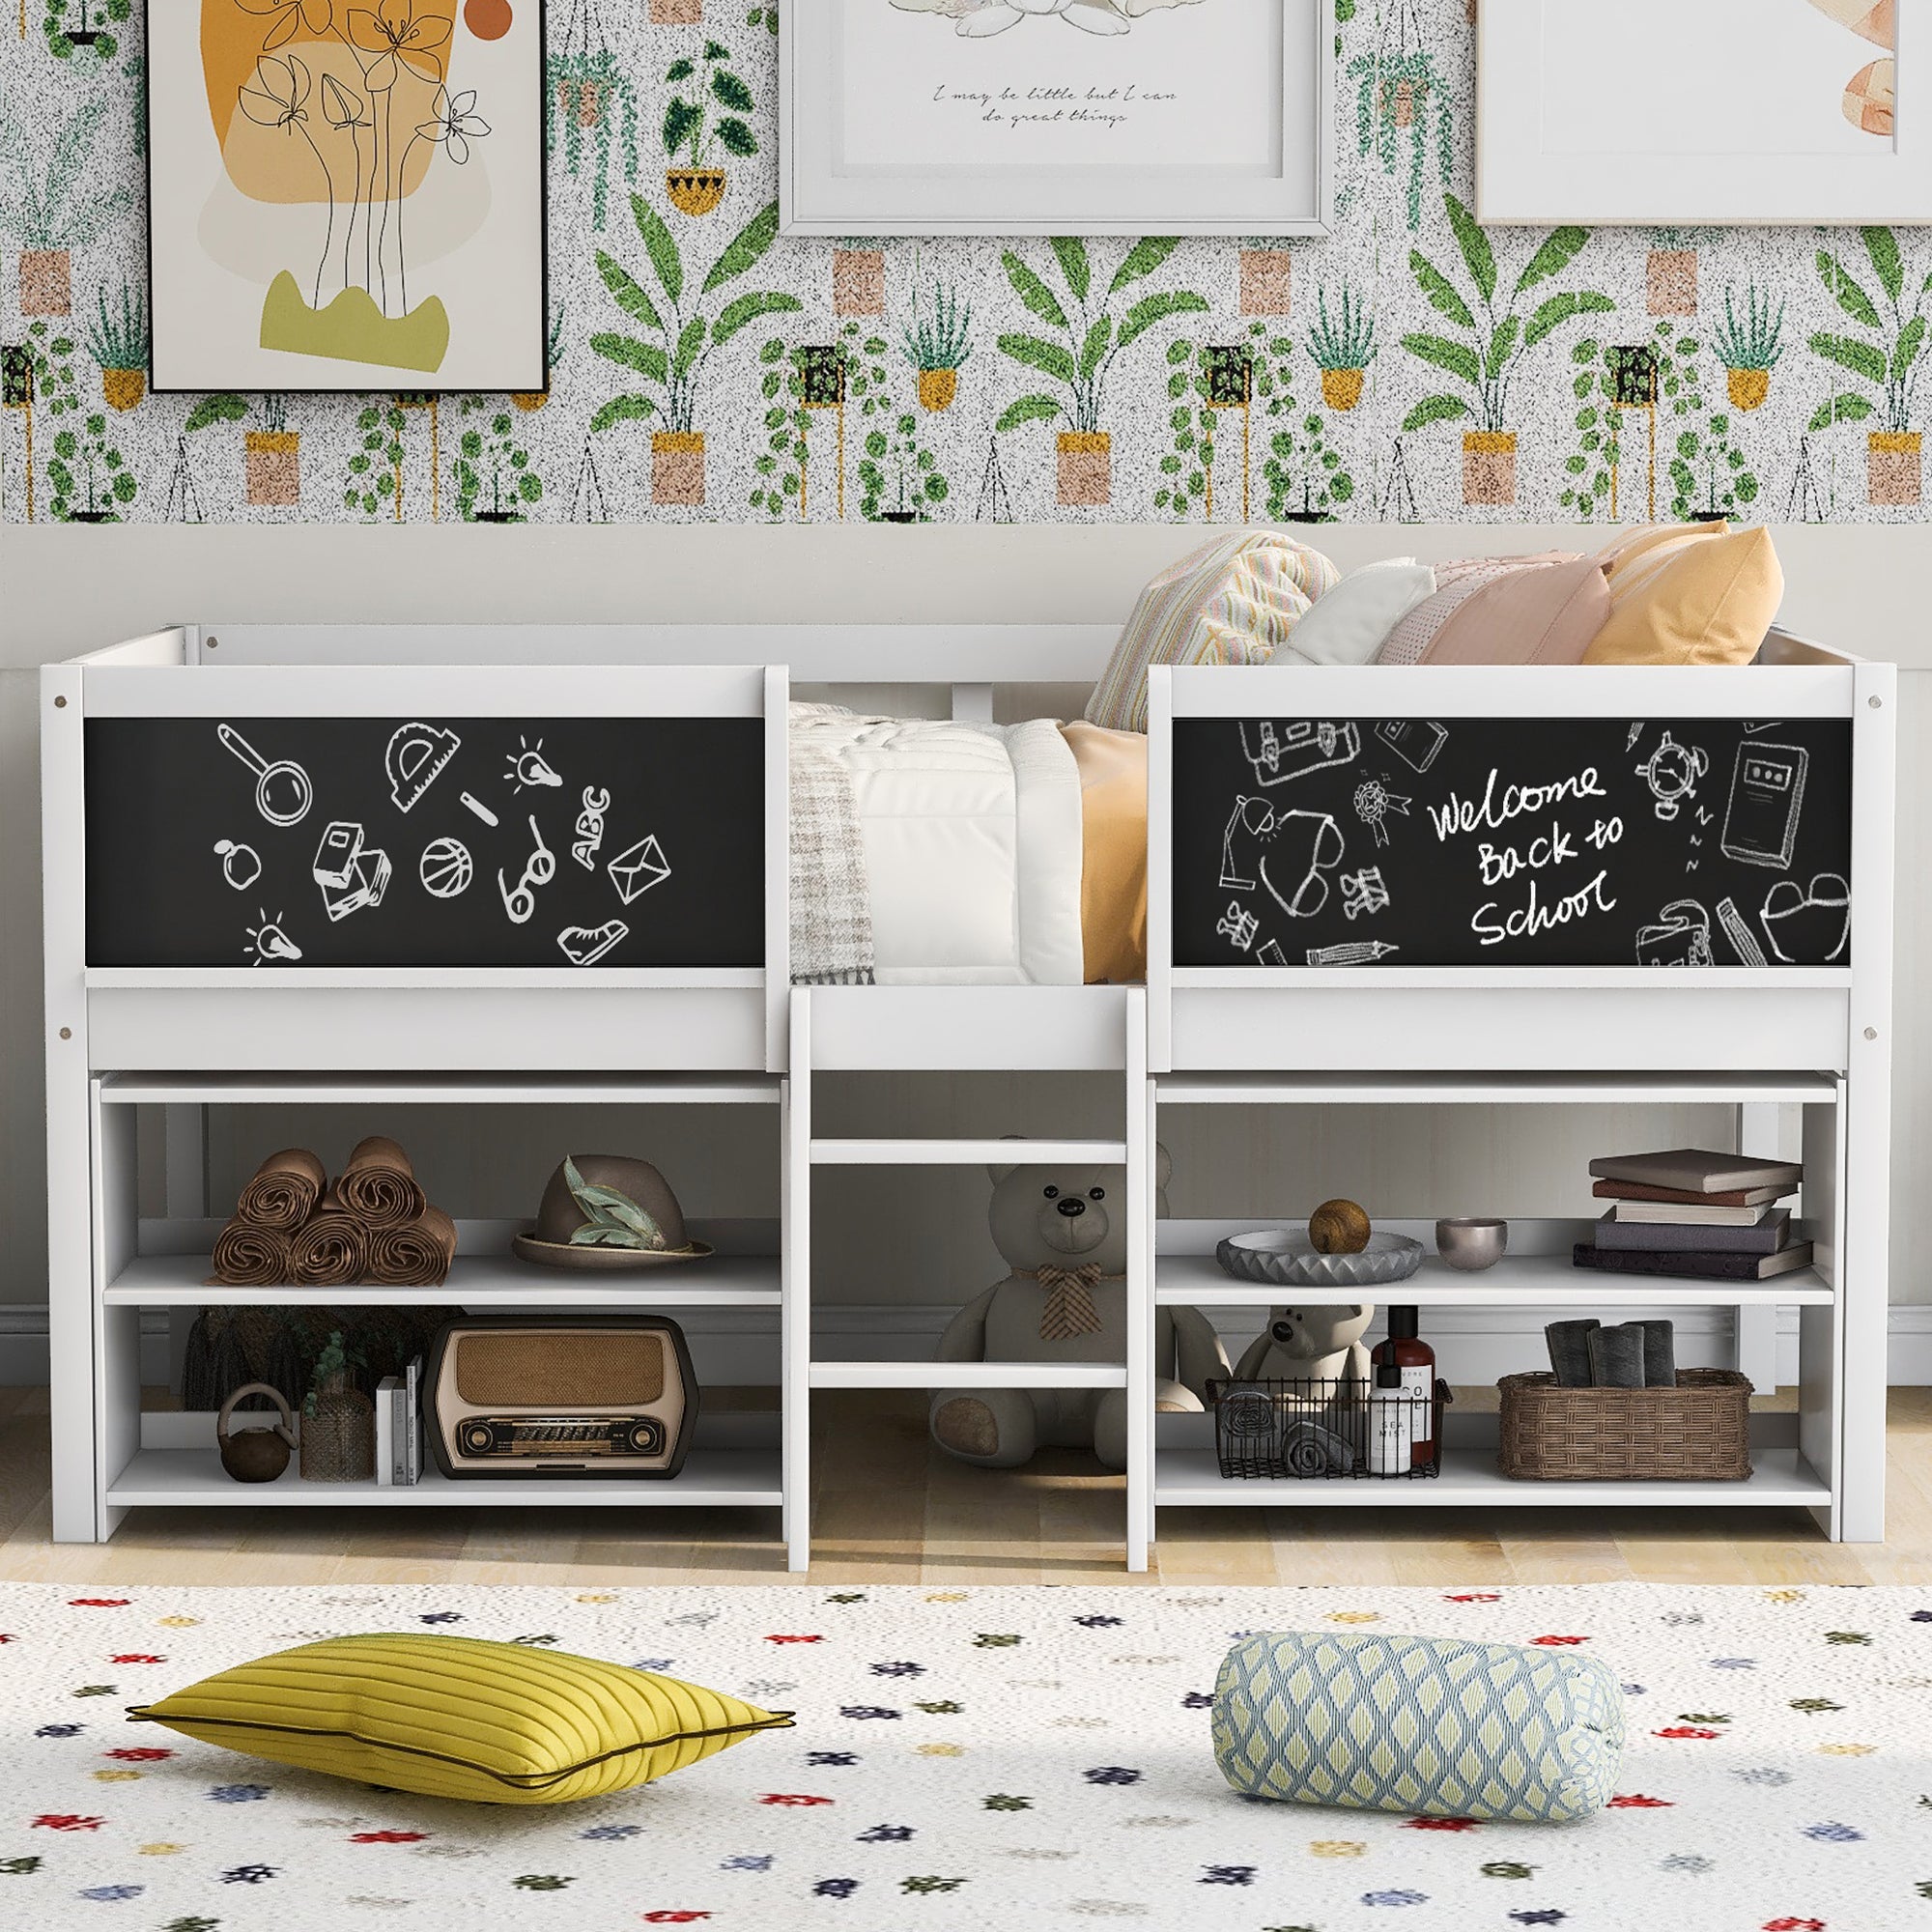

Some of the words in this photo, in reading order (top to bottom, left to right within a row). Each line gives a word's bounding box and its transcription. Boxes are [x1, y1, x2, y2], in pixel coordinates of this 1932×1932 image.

[933, 84, 945, 101] I
[951, 93, 992, 106] may
[998, 86, 1020, 99] be
[1027, 86, 1077, 100] little
[1087, 86, 1119, 100] but
[1123, 84, 1136, 101] I
[981, 108, 1005, 122] do
[1010, 109, 1065, 128] great
[1068, 108, 1128, 128] things
[572, 785, 611, 871] ABC
[1427, 767, 1606, 842] Welcome
[1477, 820, 1578, 886] Back
[1584, 816, 1624, 850] to
[1470, 869, 1617, 946] School
